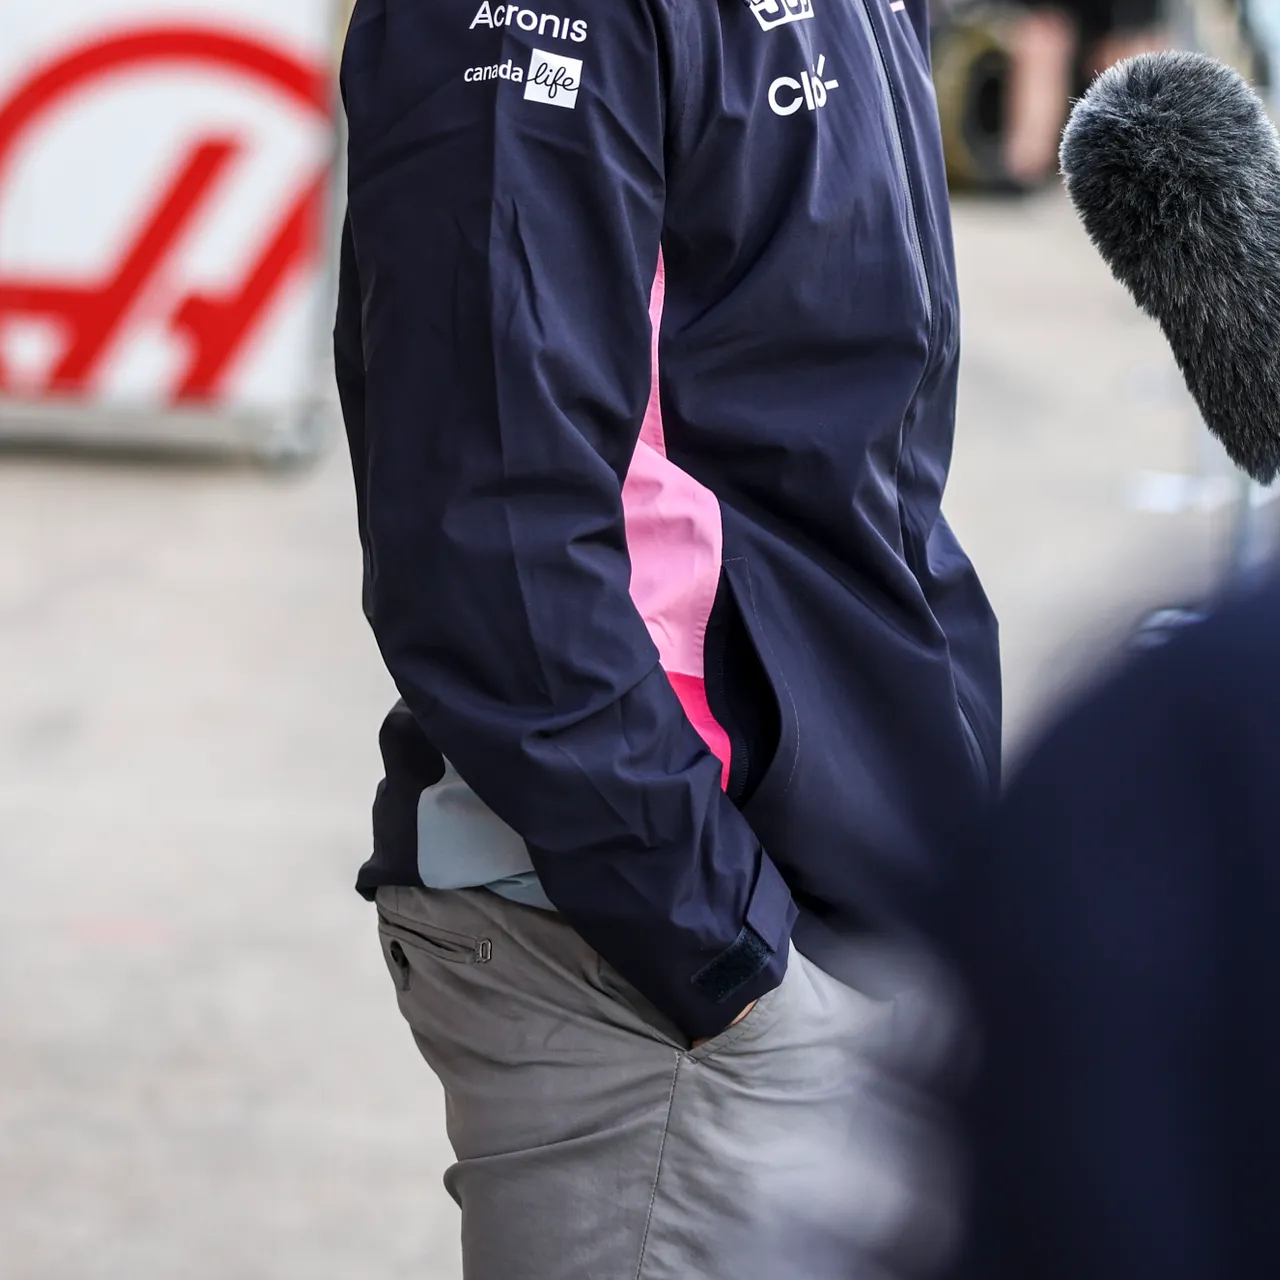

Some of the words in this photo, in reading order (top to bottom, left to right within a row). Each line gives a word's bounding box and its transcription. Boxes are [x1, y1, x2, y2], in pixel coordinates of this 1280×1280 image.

[468, 0, 588, 43] Acronis
[463, 58, 524, 83] canada
[526, 61, 580, 99] life
